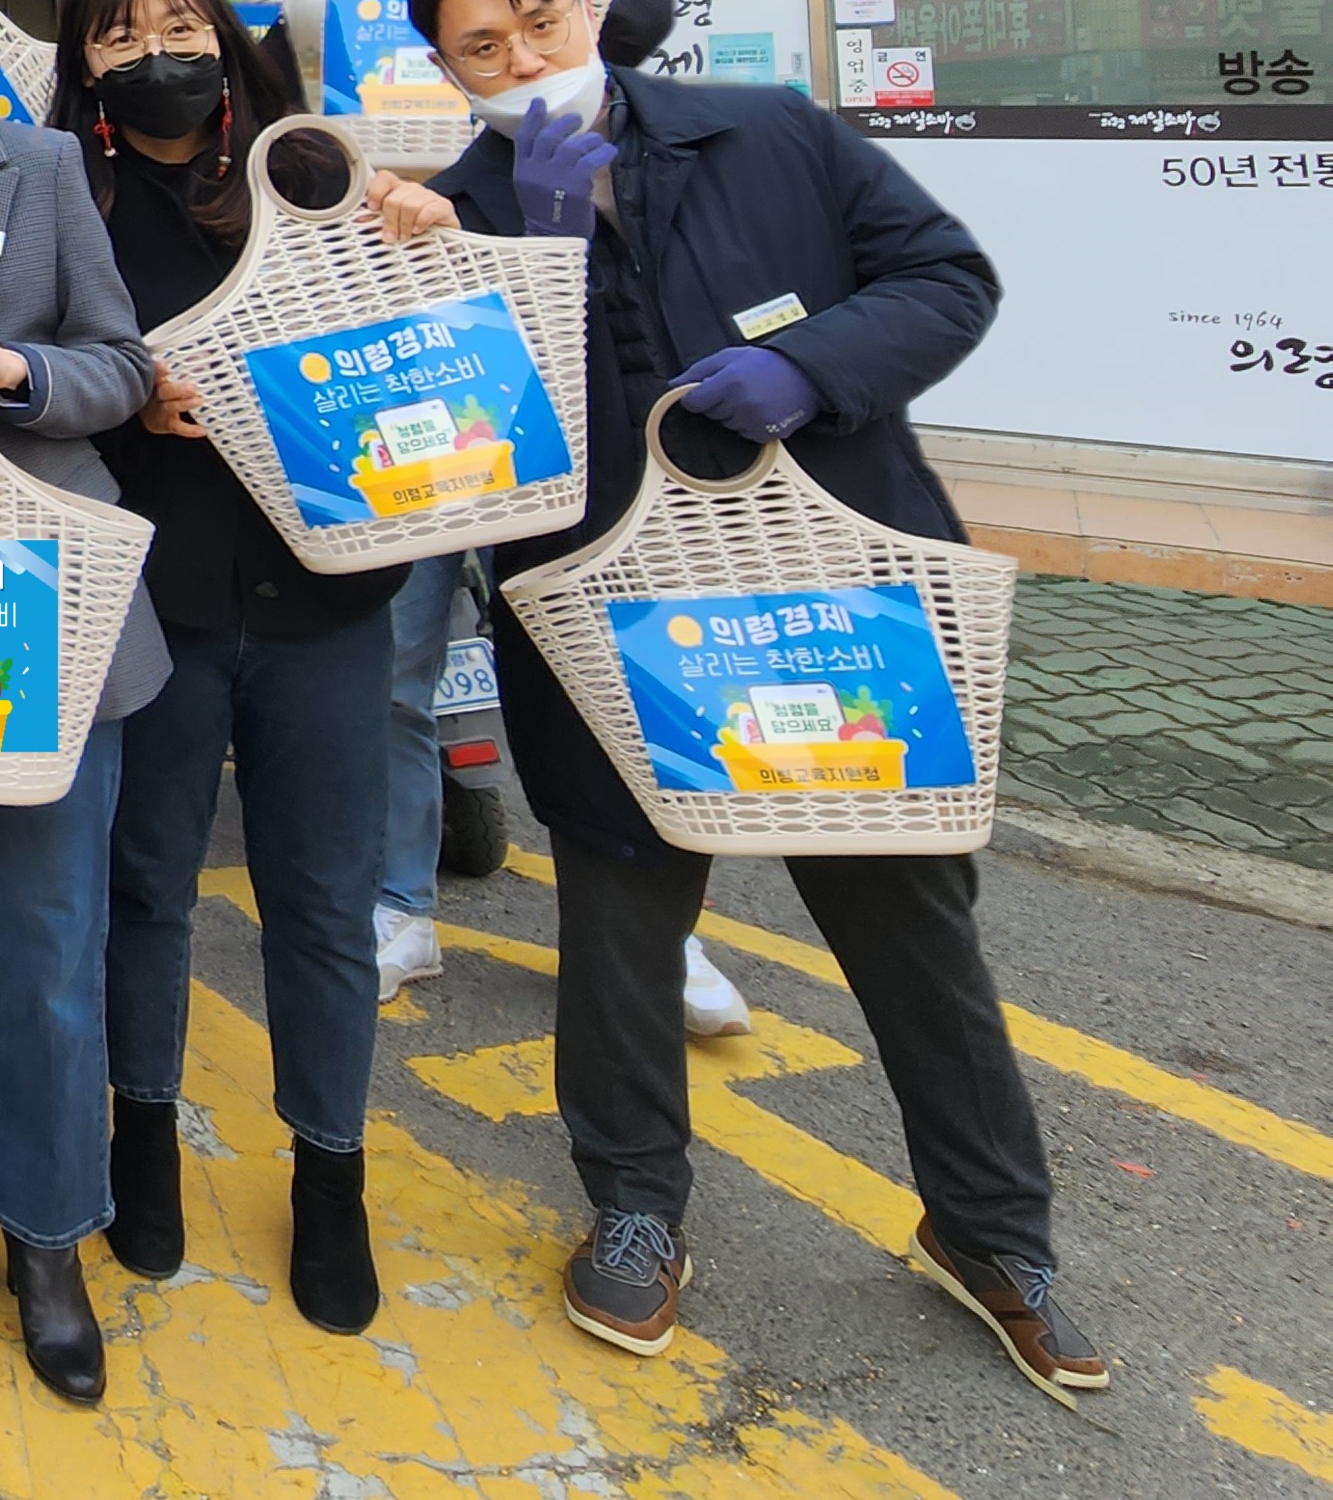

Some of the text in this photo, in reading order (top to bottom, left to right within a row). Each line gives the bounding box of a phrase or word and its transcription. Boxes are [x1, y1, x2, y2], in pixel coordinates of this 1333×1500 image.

[846, 38, 868, 94] 영업중
[1217, 49, 1315, 95] 방송
[1162, 154, 1258, 188] 50년
[1168, 310, 1283, 331] since 1964
[333, 322, 456, 378] 의령경제
[313, 353, 486, 415] 살리는 착한소비
[709, 602, 855, 647] 의령경제
[679, 644, 886, 679] 살리는 착한소비
